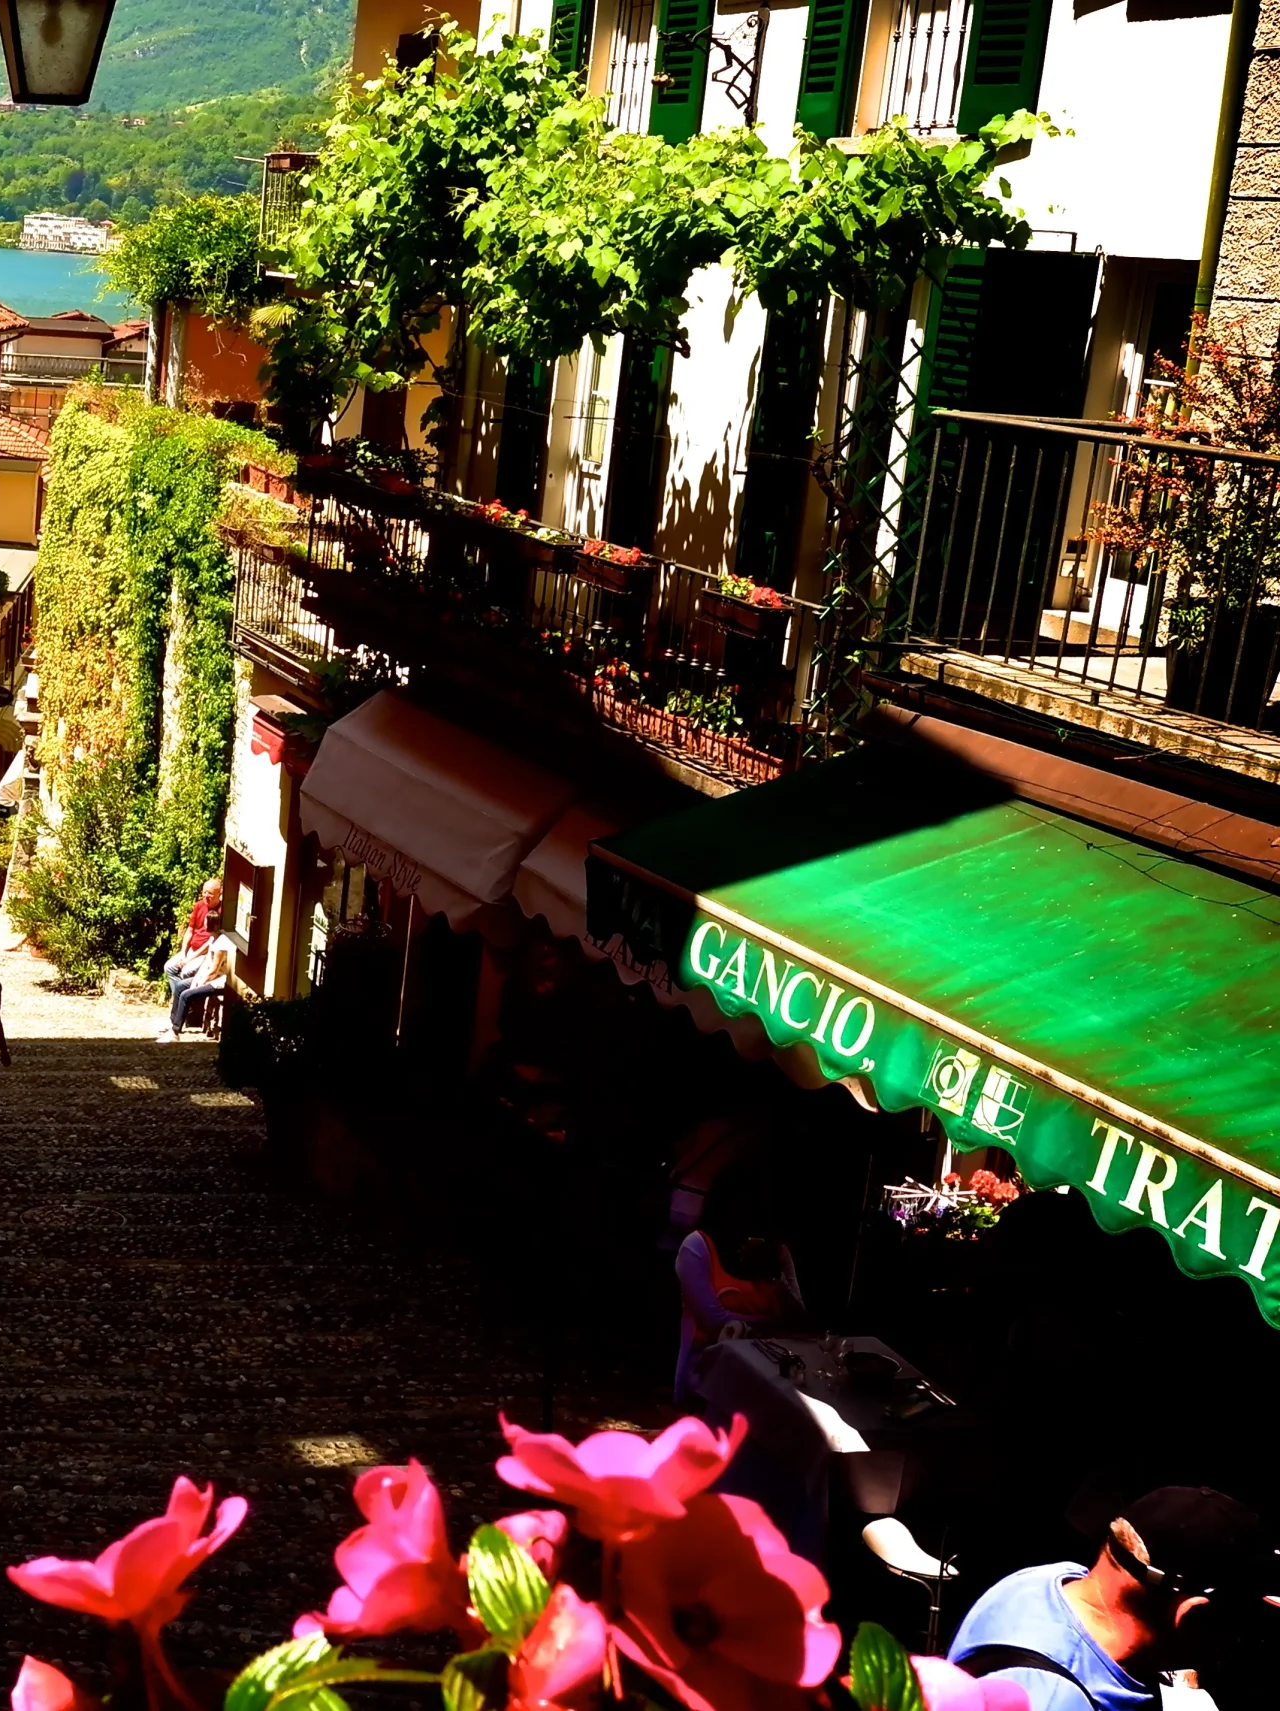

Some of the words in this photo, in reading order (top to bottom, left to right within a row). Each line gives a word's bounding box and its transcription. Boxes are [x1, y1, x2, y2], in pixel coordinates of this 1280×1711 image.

[342, 822, 387, 871] Italian
[387, 850, 422, 892] Style
[1085, 1117, 1280, 1282] TRAT
